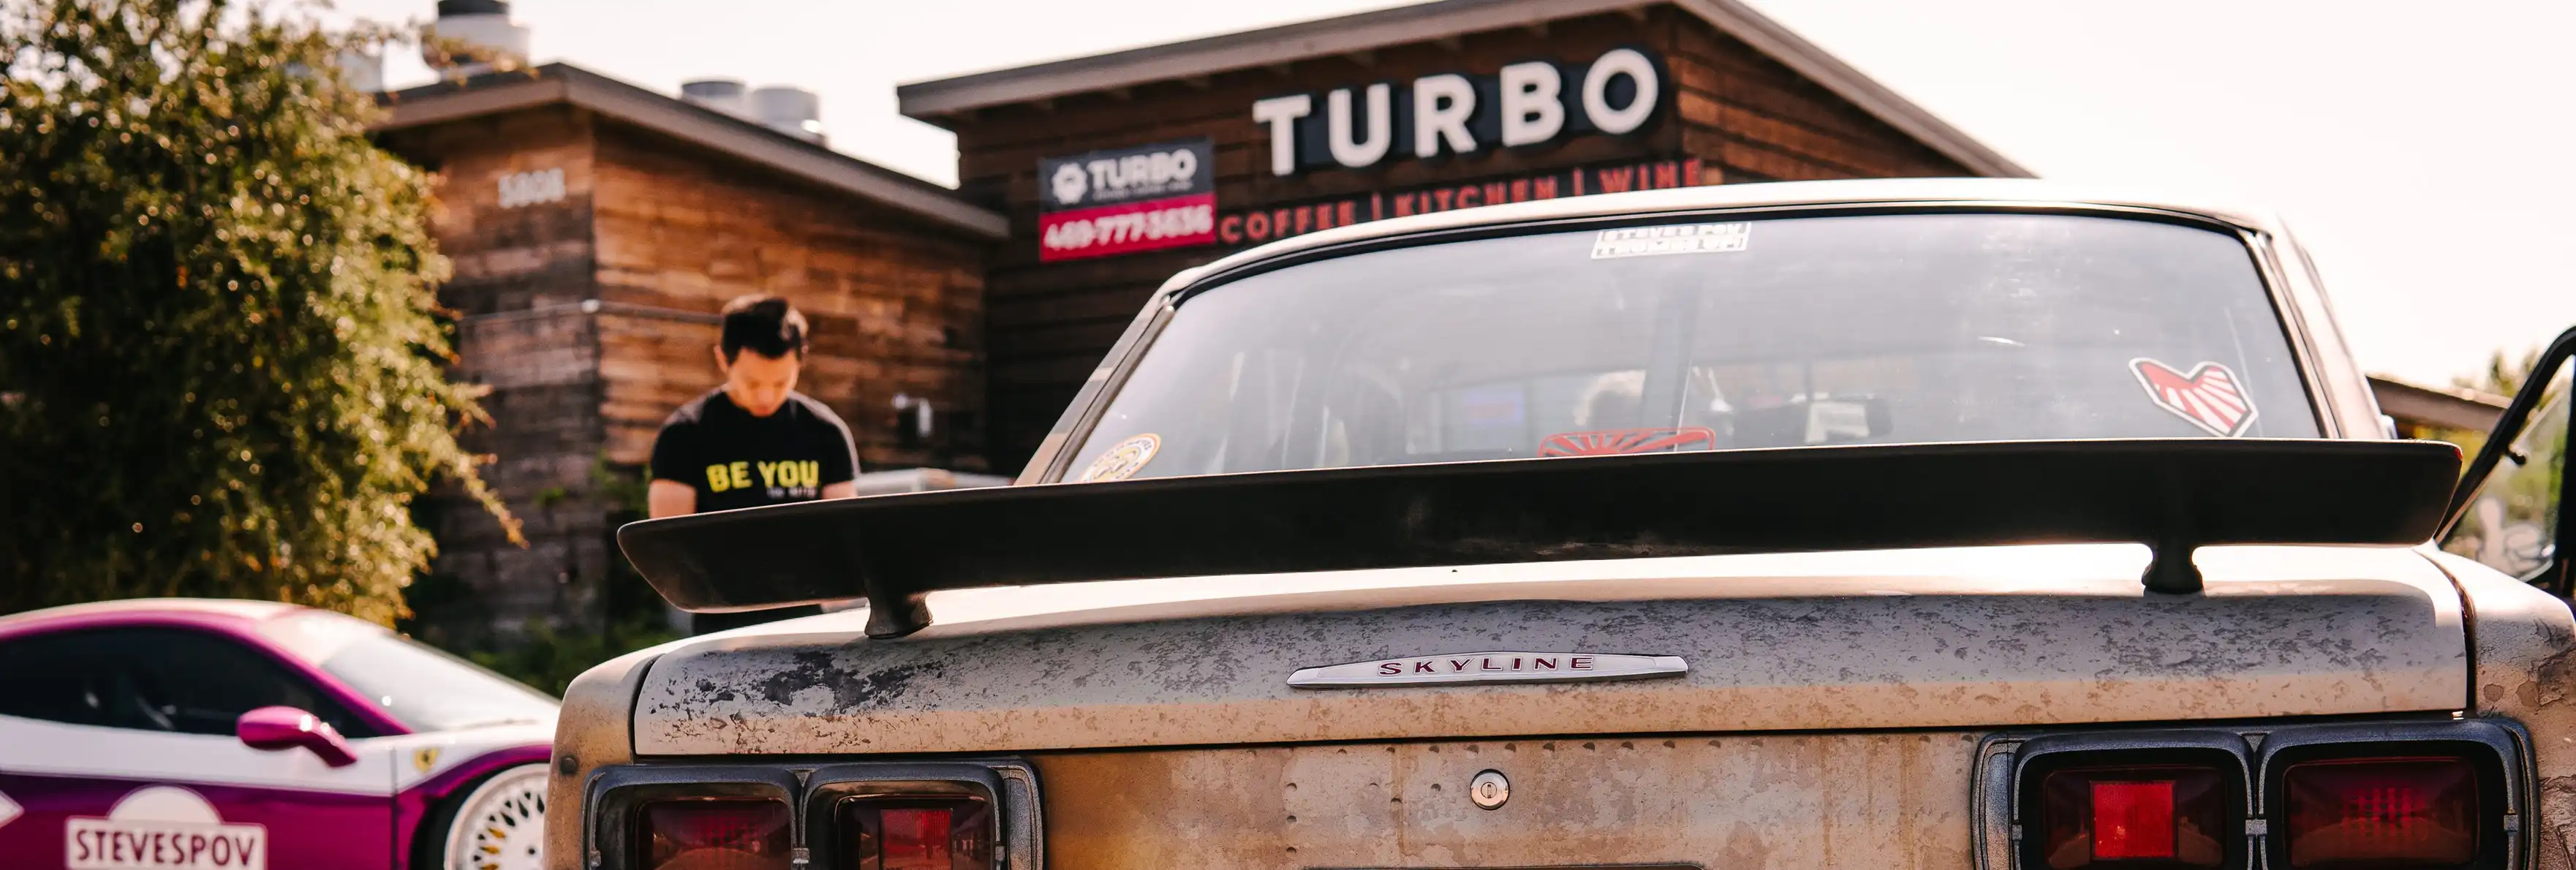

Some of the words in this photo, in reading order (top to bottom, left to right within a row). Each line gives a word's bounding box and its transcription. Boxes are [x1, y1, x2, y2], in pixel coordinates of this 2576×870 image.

[1252, 48, 1660, 176] TURBO
[1087, 148, 1198, 190] TURBO
[1220, 200, 1356, 245] COFFEE
[1394, 175, 1557, 218] KITCHEN
[1598, 158, 1701, 193] WINE
[706, 461, 752, 493] BE
[757, 460, 819, 488] YOU
[1378, 656, 1594, 677] SKYLINE
[76, 829, 254, 866] STEVESPOV
